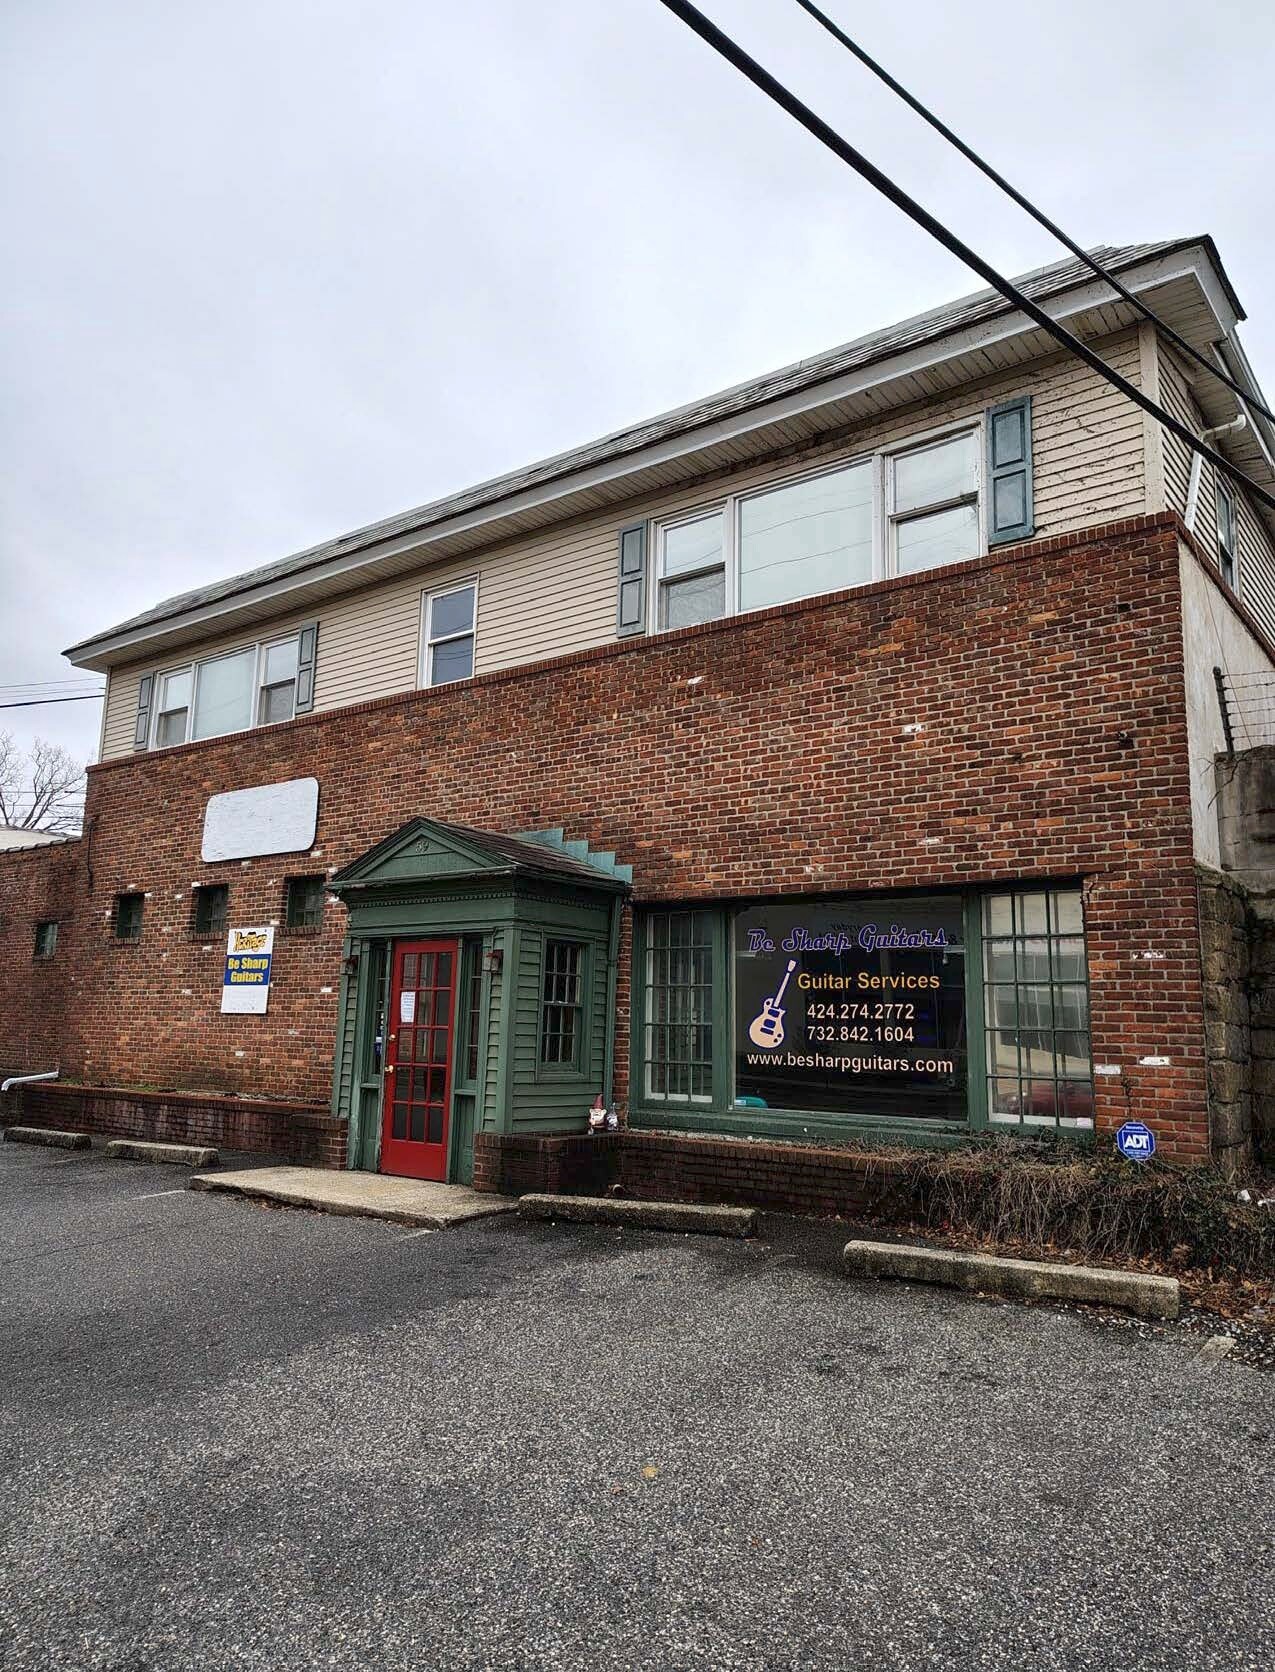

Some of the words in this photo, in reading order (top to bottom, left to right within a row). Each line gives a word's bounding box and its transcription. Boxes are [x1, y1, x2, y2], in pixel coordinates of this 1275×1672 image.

[747, 928, 776, 953] Be
[782, 927, 852, 956] Sharp
[858, 923, 949, 953] Guitars
[228, 957, 240, 970] Be
[241, 957, 269, 970] Sharp
[230, 971, 264, 983] Guitars
[797, 973, 852, 989] Guitar
[857, 972, 940, 989] Services
[807, 1004, 914, 1020] 424.274.2772
[807, 1026, 914, 1042] 732.842.1604
[747, 1052, 953, 1073] www.besharpguitars.com
[1124, 1134, 1149, 1149] ADT
